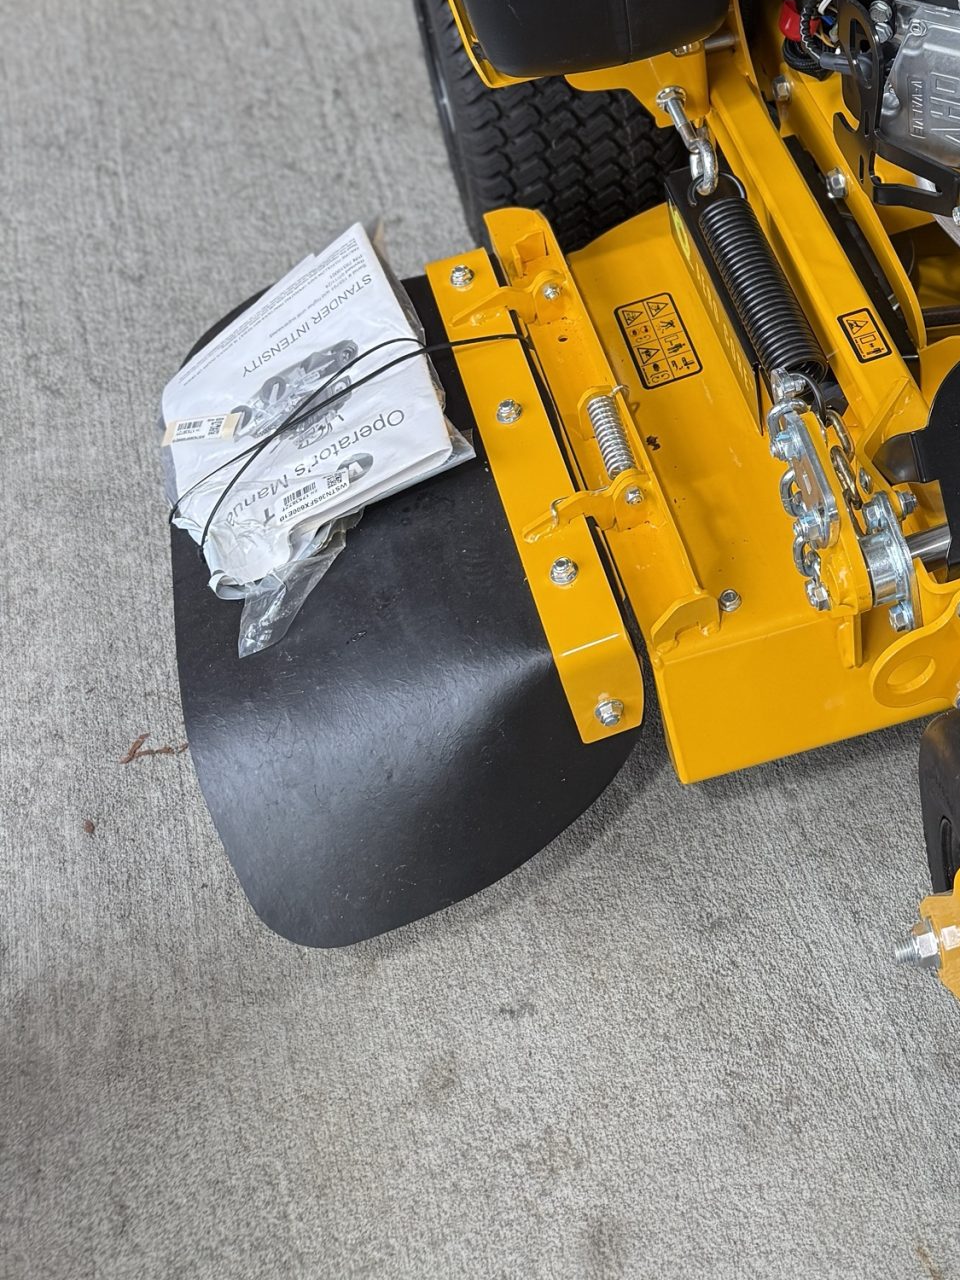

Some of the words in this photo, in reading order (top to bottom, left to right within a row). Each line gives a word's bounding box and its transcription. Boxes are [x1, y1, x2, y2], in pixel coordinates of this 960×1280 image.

[311, 274, 372, 324] STANDER
[242, 322, 309, 377] INTENSITY
[294, 409, 405, 475] Operator's
[225, 473, 289, 526] Manua
